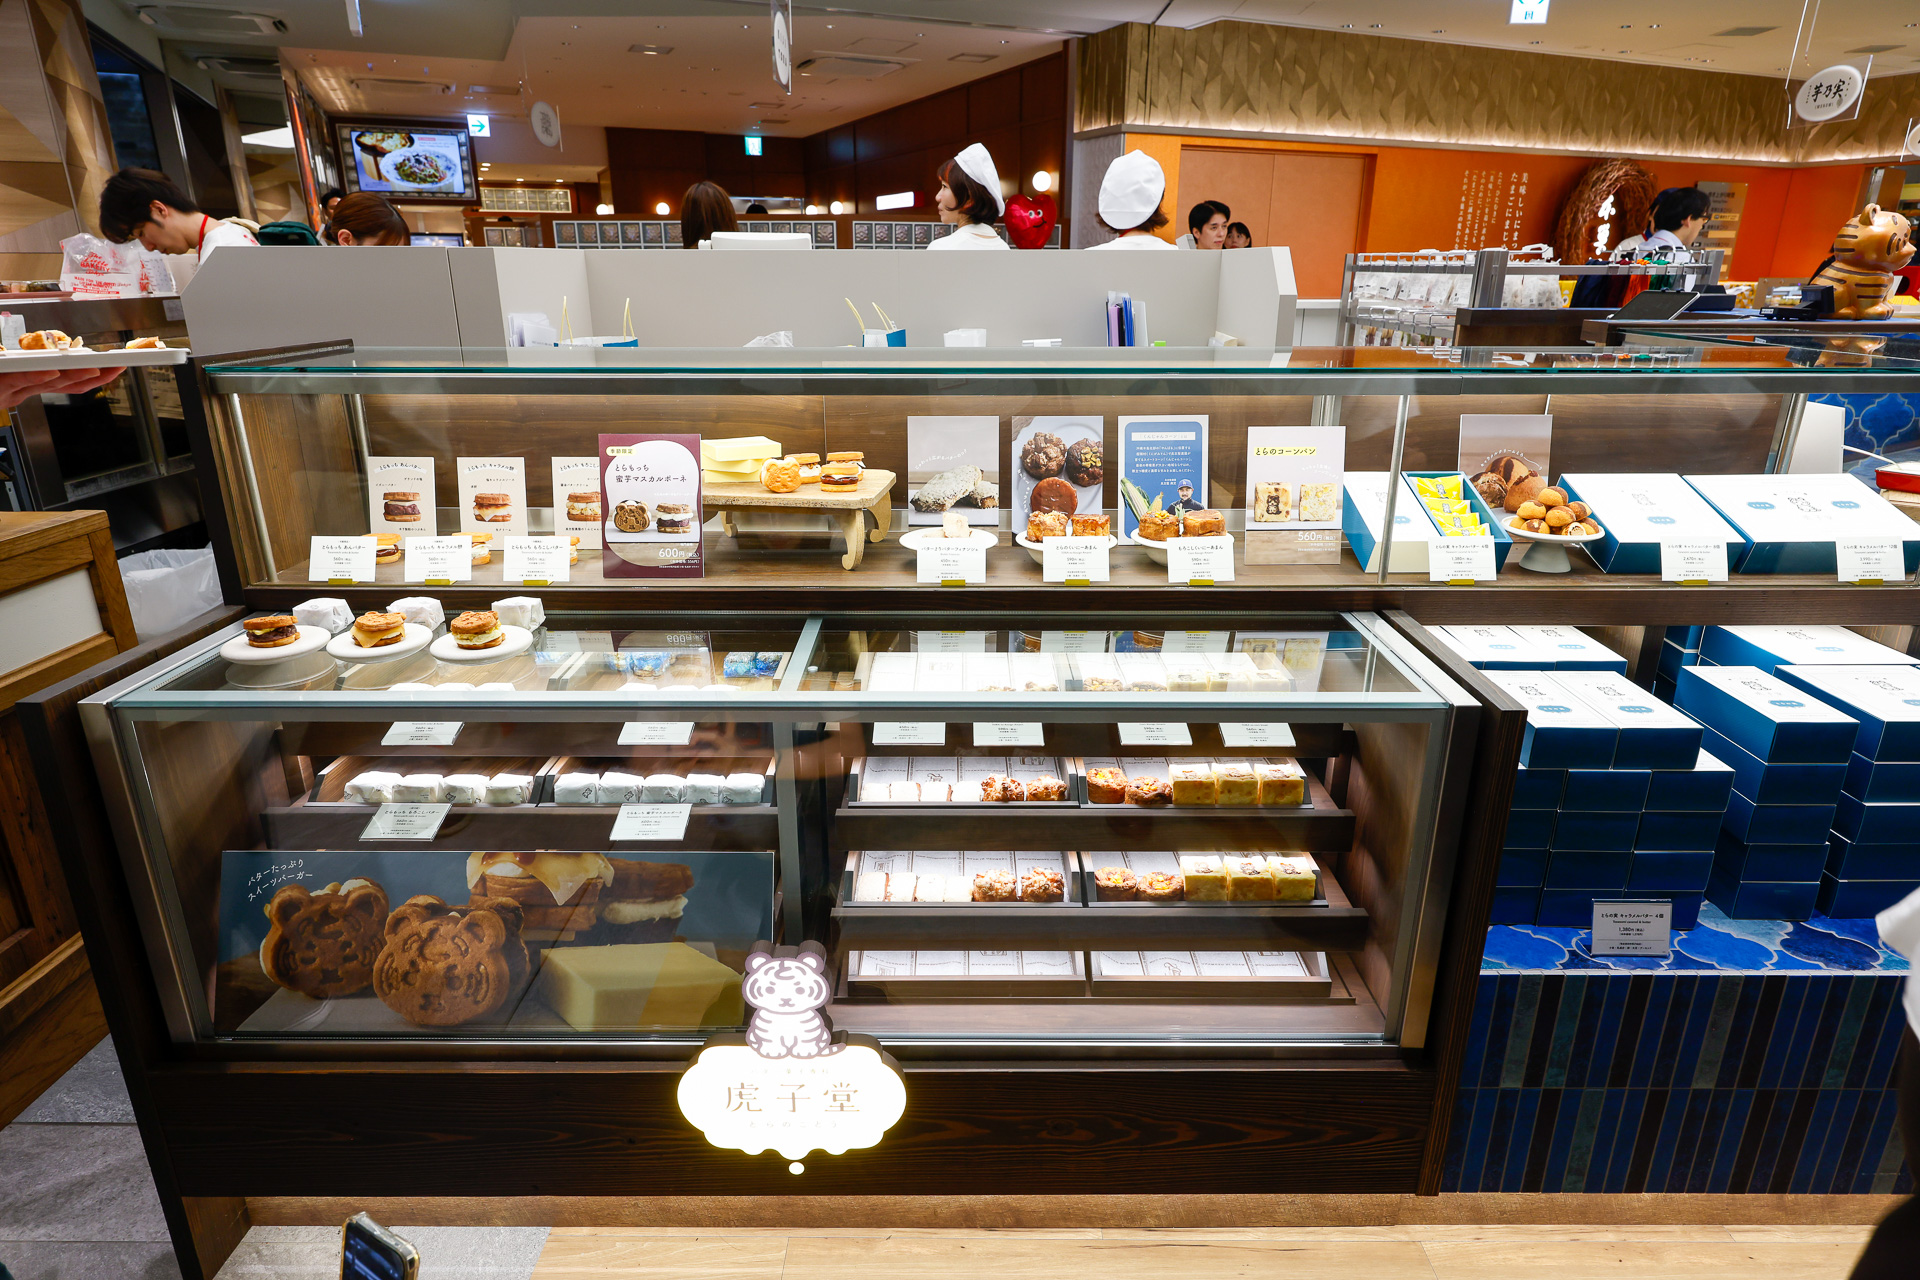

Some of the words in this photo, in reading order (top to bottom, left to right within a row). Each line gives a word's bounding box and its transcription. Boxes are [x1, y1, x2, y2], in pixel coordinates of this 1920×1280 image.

[1812, 79, 1846, 102] 芋乃実
[248, 859, 304, 886] バターたっぷり
[248, 871, 313, 902] スイーツバーガー
[726, 1082, 860, 1113] 虎子堂
